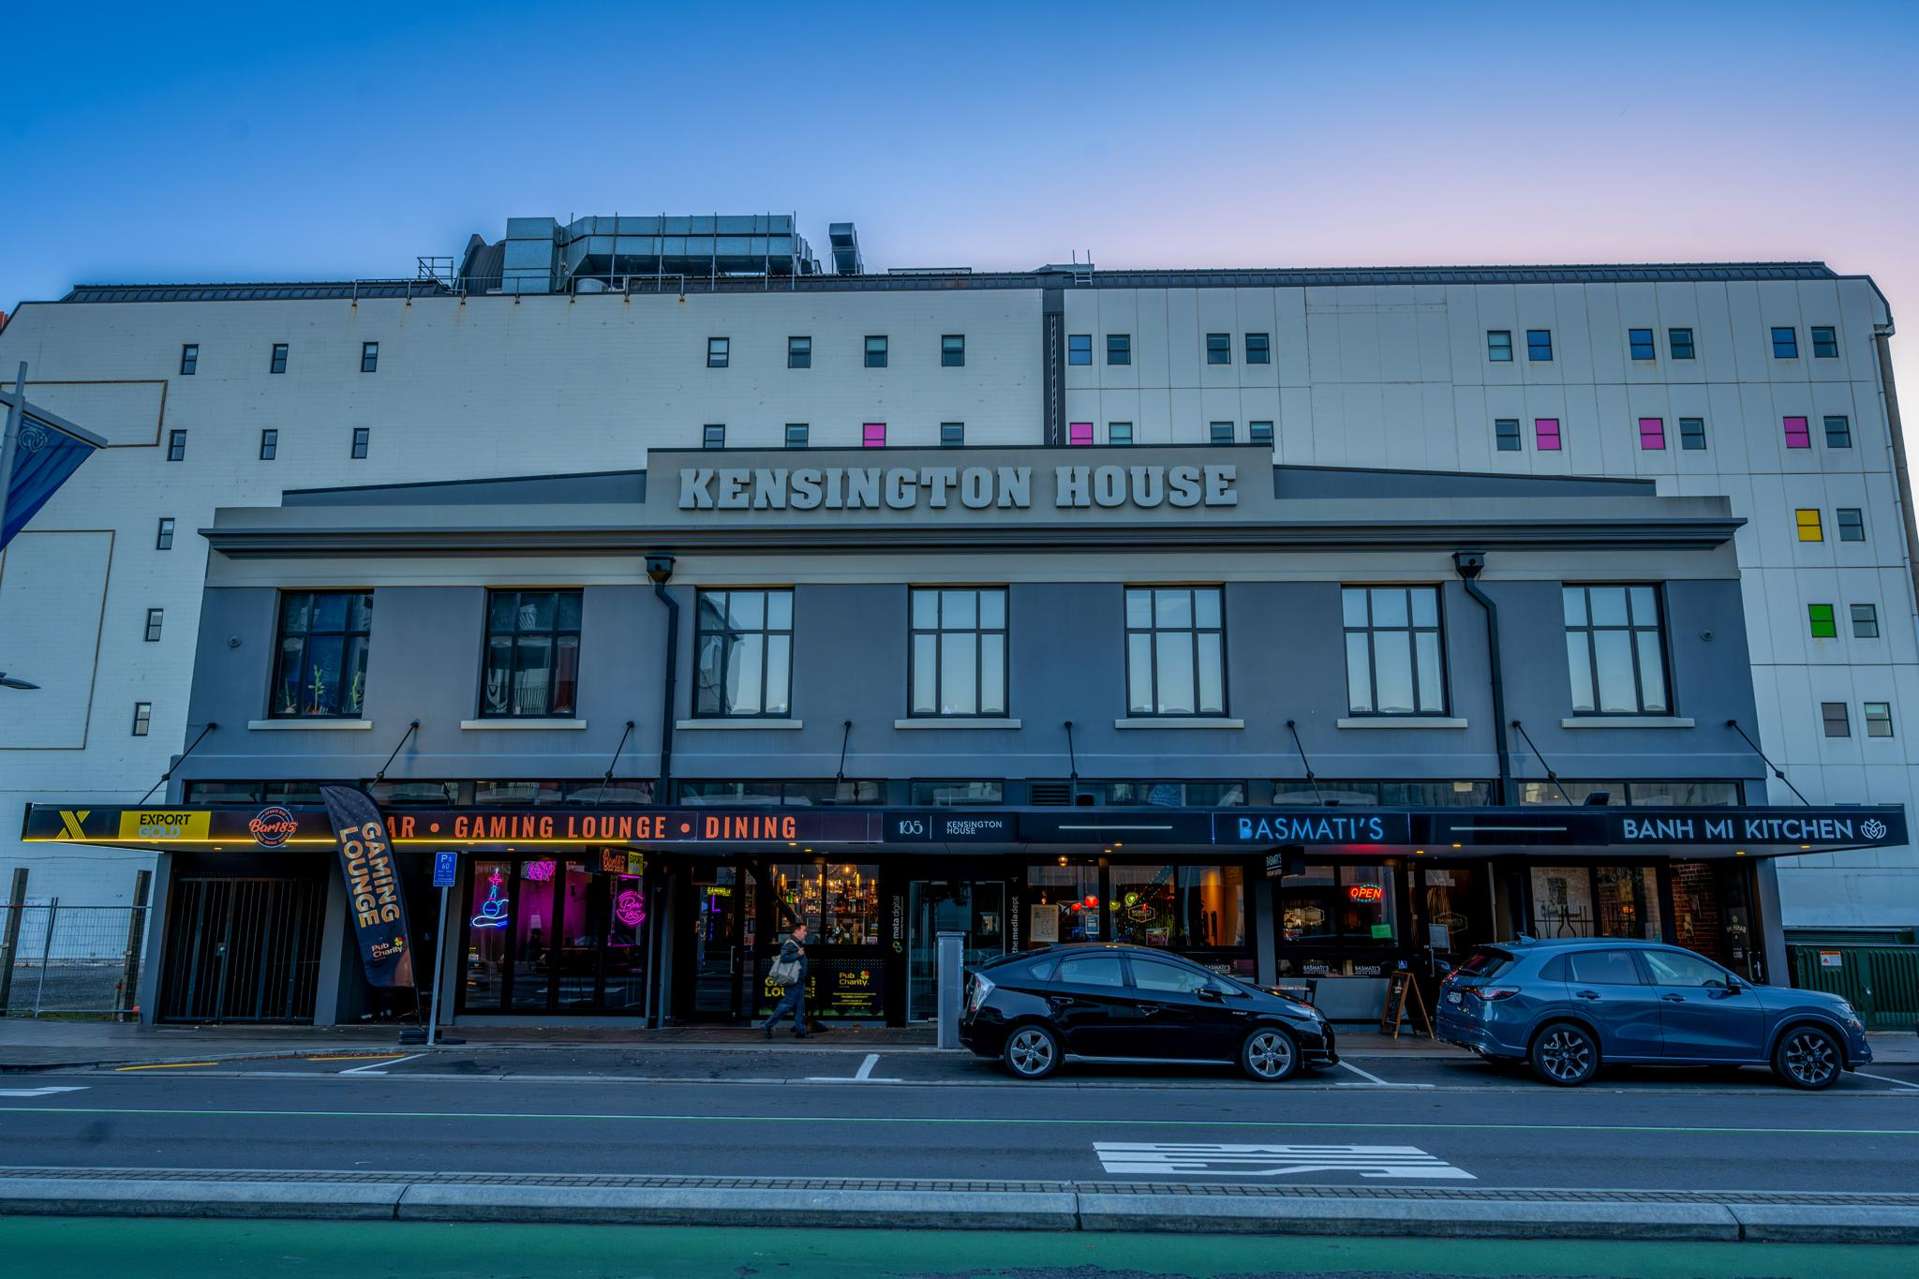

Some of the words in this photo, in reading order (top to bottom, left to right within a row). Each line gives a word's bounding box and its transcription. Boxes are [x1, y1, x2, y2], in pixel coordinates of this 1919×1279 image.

[678, 466, 1031, 510] KENSINGTON
[1055, 464, 1238, 508] HOUSE
[139, 813, 192, 826] EXPORT
[249, 818, 298, 833] Bar185
[946, 820, 1003, 828] KENSINGTON
[138, 825, 181, 838] GOLD
[386, 815, 416, 838] AR
[454, 815, 554, 839] GAMING
[567, 815, 667, 839] LOUNGE
[705, 816, 797, 839] DINING
[946, 827, 977, 835] HOUSE
[1238, 816, 1385, 841] BASMATI'S
[1622, 818, 1695, 839] BANH
[1704, 818, 1735, 839] MI
[1744, 818, 1855, 839] KITCHEN
[440, 854, 448, 863] P
[338, 825, 381, 928] LOUNGE
[361, 821, 400, 922] GAMING
[1350, 887, 1383, 899] OPEN
[371, 942, 389, 952] Pub
[838, 971, 855, 979] Pub
